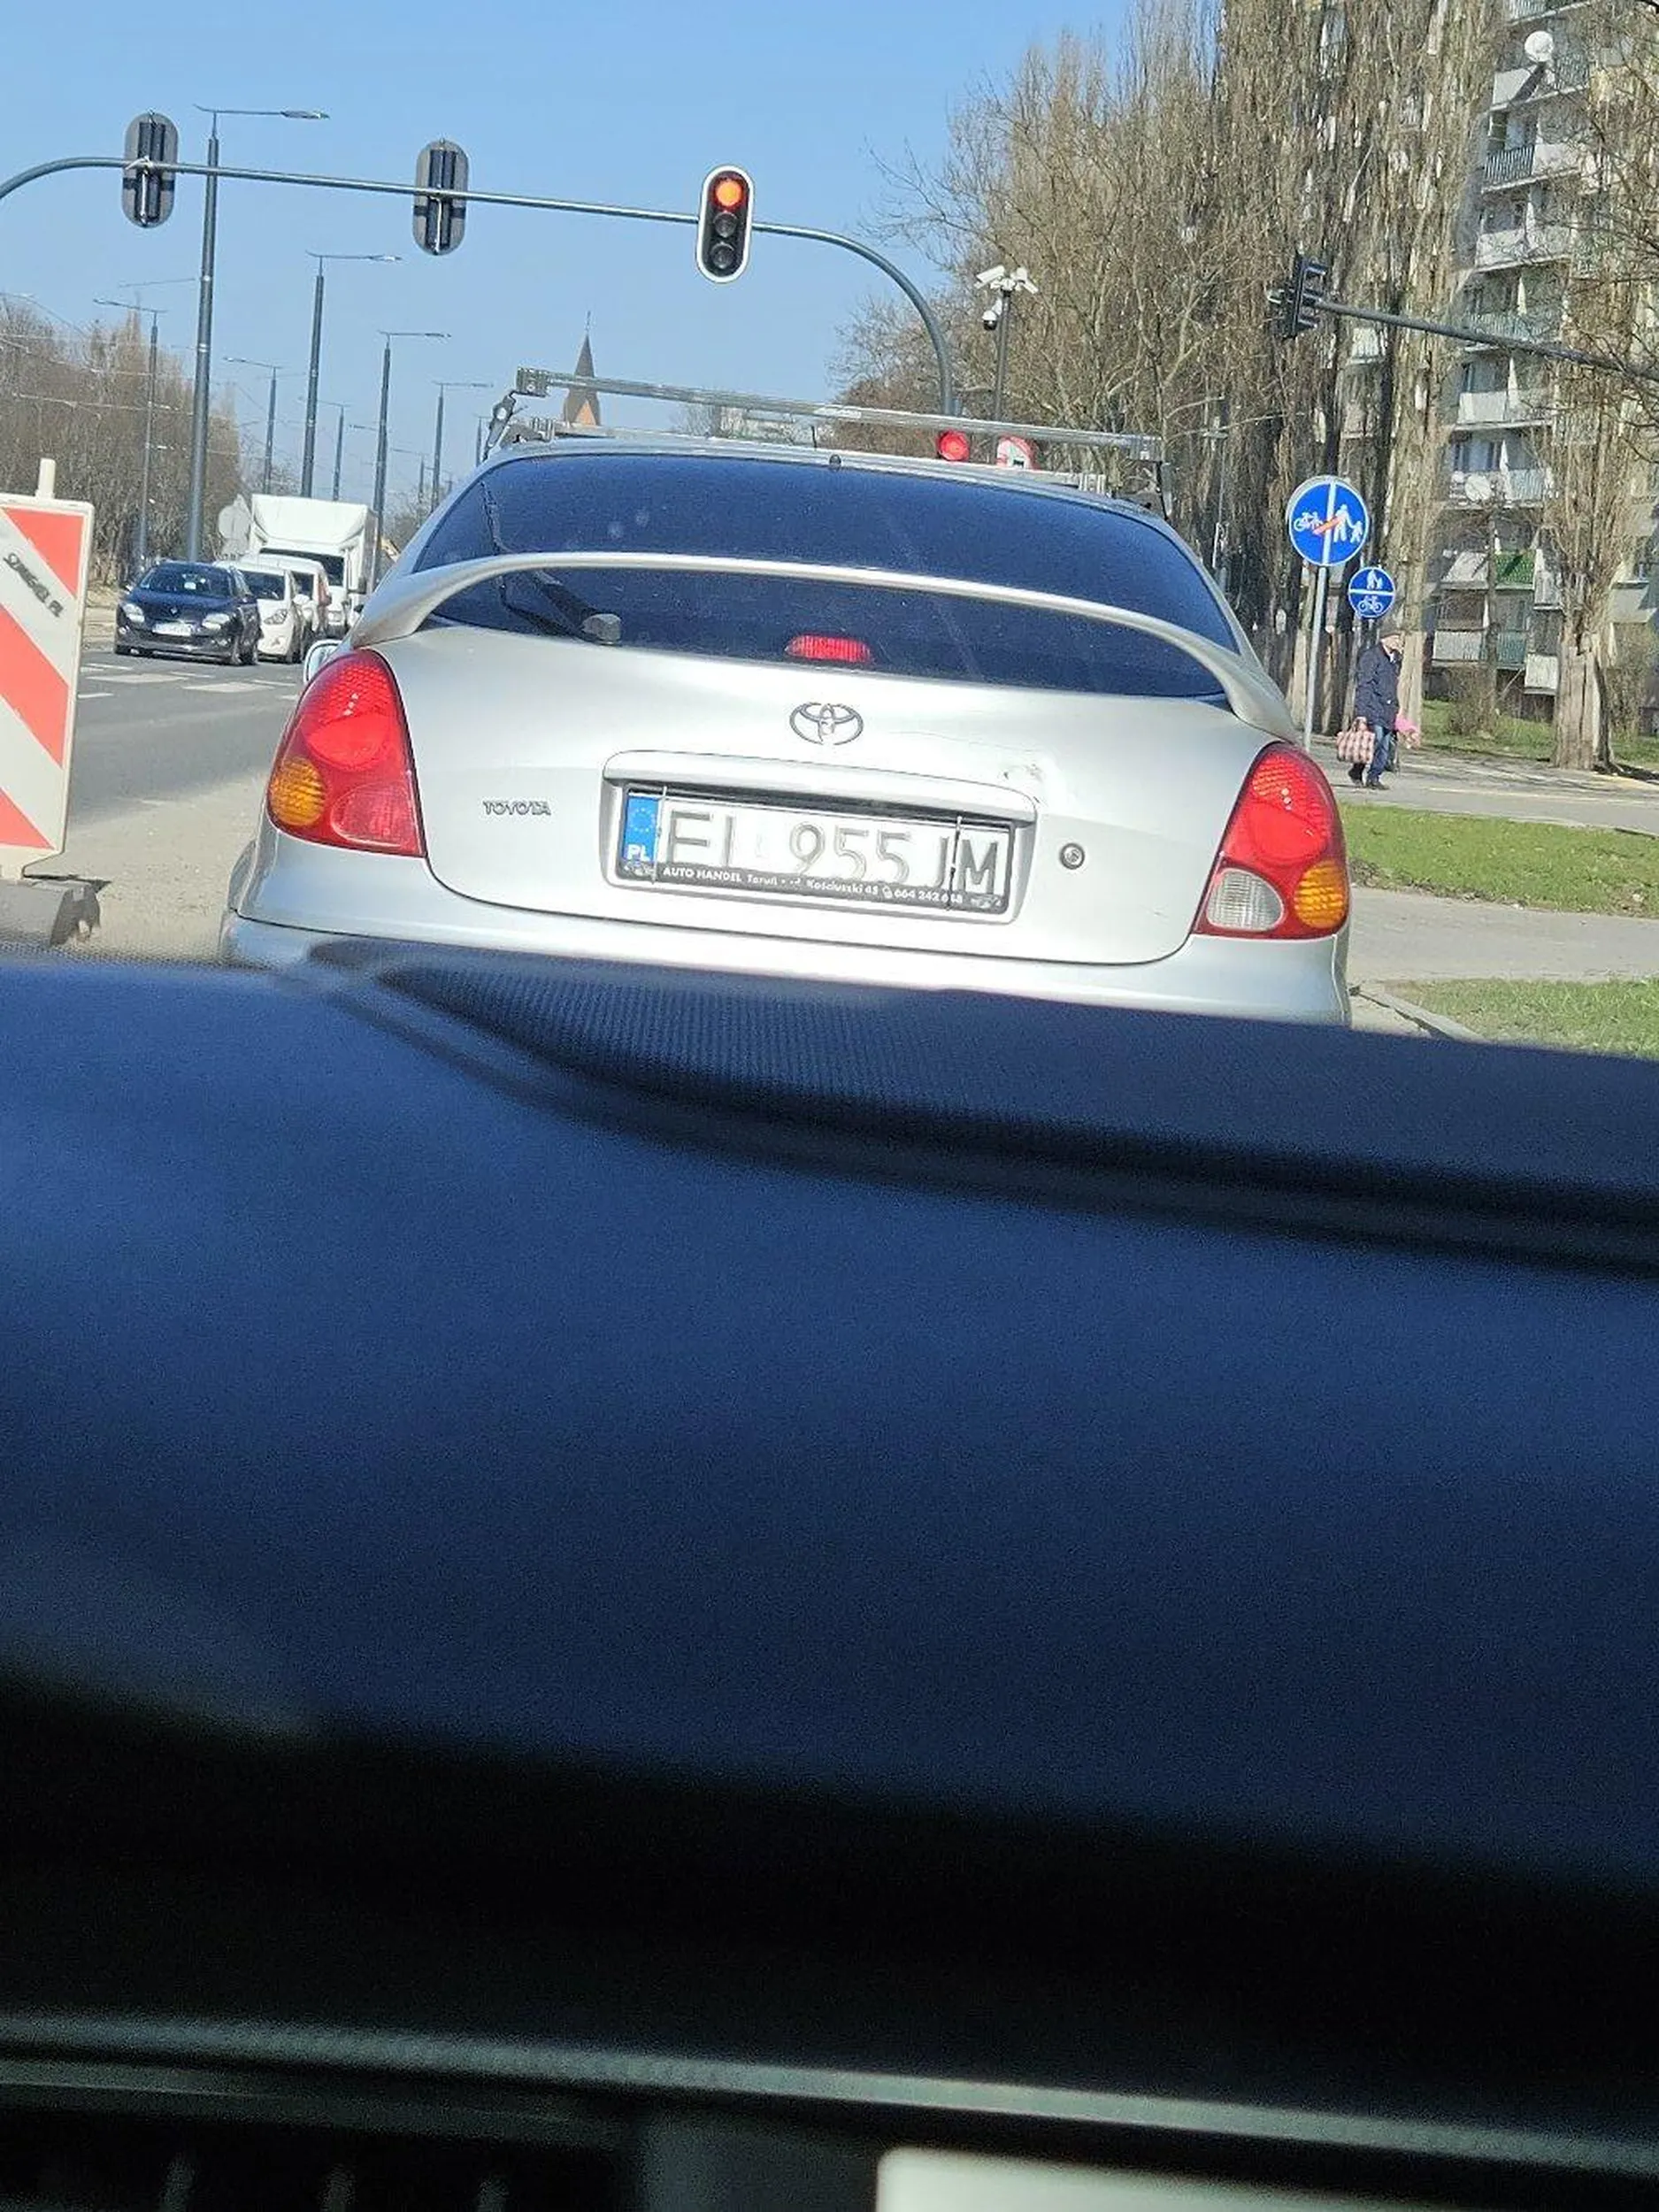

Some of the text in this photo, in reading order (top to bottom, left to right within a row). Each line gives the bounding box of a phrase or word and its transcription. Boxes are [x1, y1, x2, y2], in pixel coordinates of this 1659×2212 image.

[482, 801, 551, 815] TOYOTA
[627, 843, 650, 861] PL
[663, 867, 695, 878] AUTO
[696, 870, 741, 882] HANDEL
